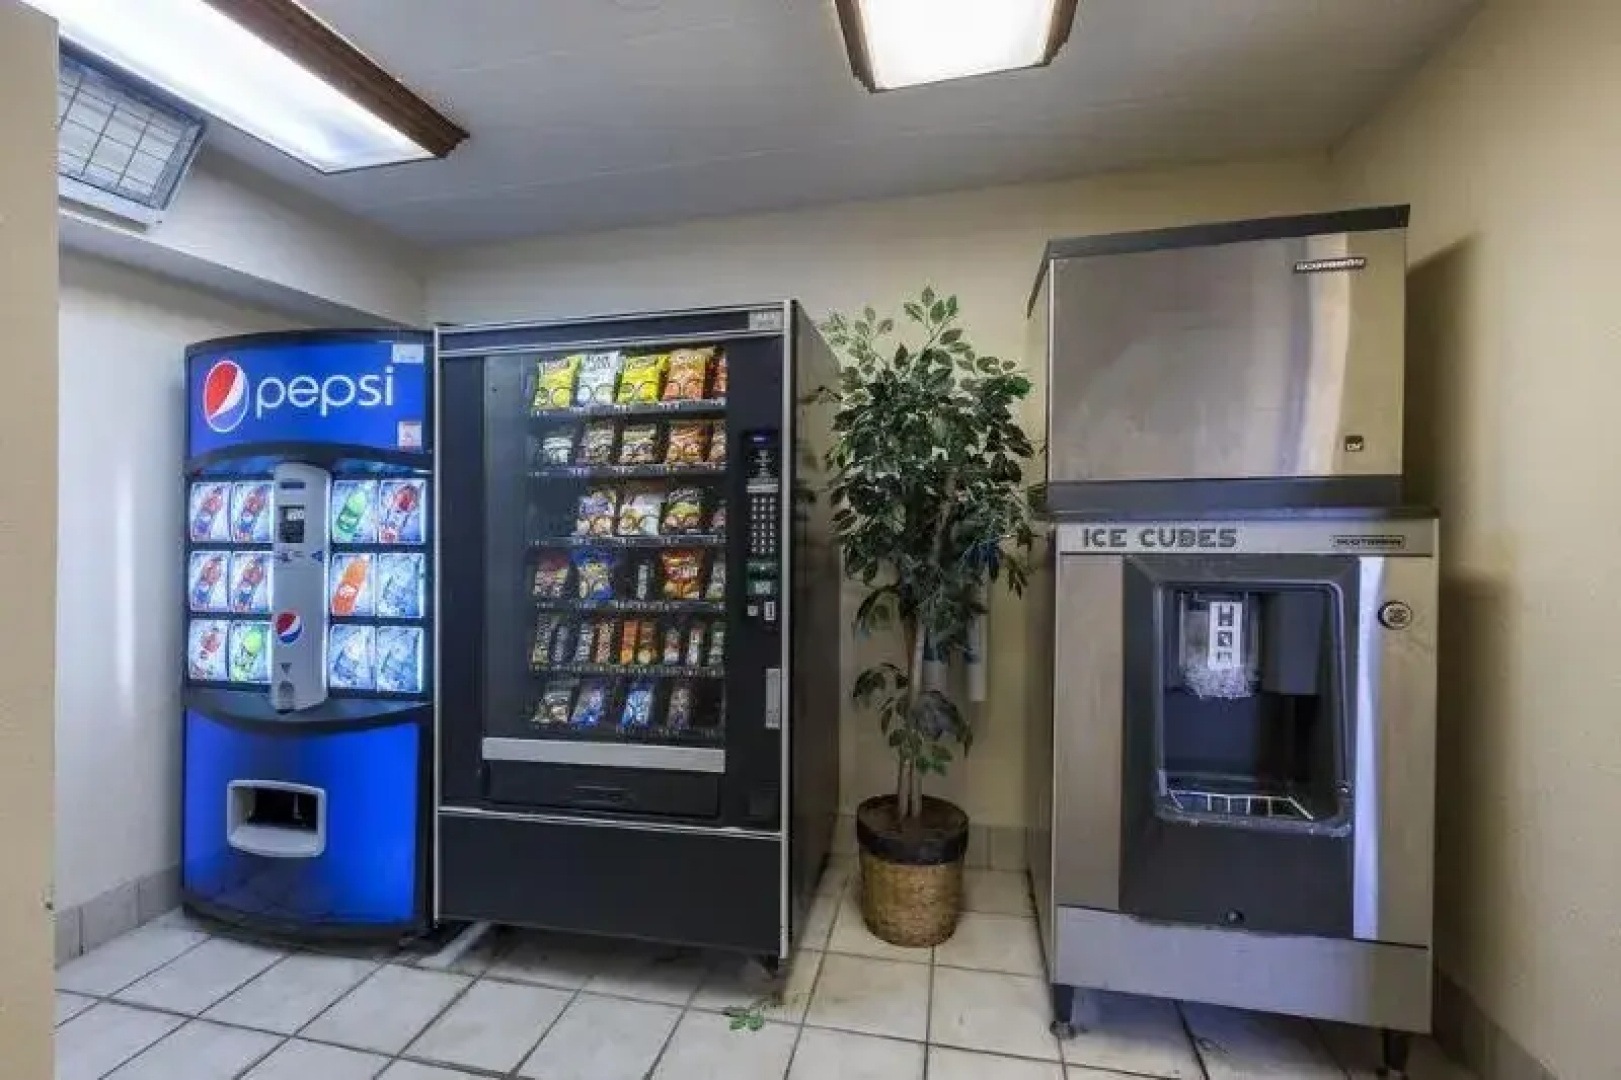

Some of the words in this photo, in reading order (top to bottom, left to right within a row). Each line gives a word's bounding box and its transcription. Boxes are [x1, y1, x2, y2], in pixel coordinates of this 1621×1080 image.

[256, 366, 394, 420] pepsi
[1083, 528, 1128, 548] ICE
[1139, 528, 1237, 548] CUBES
